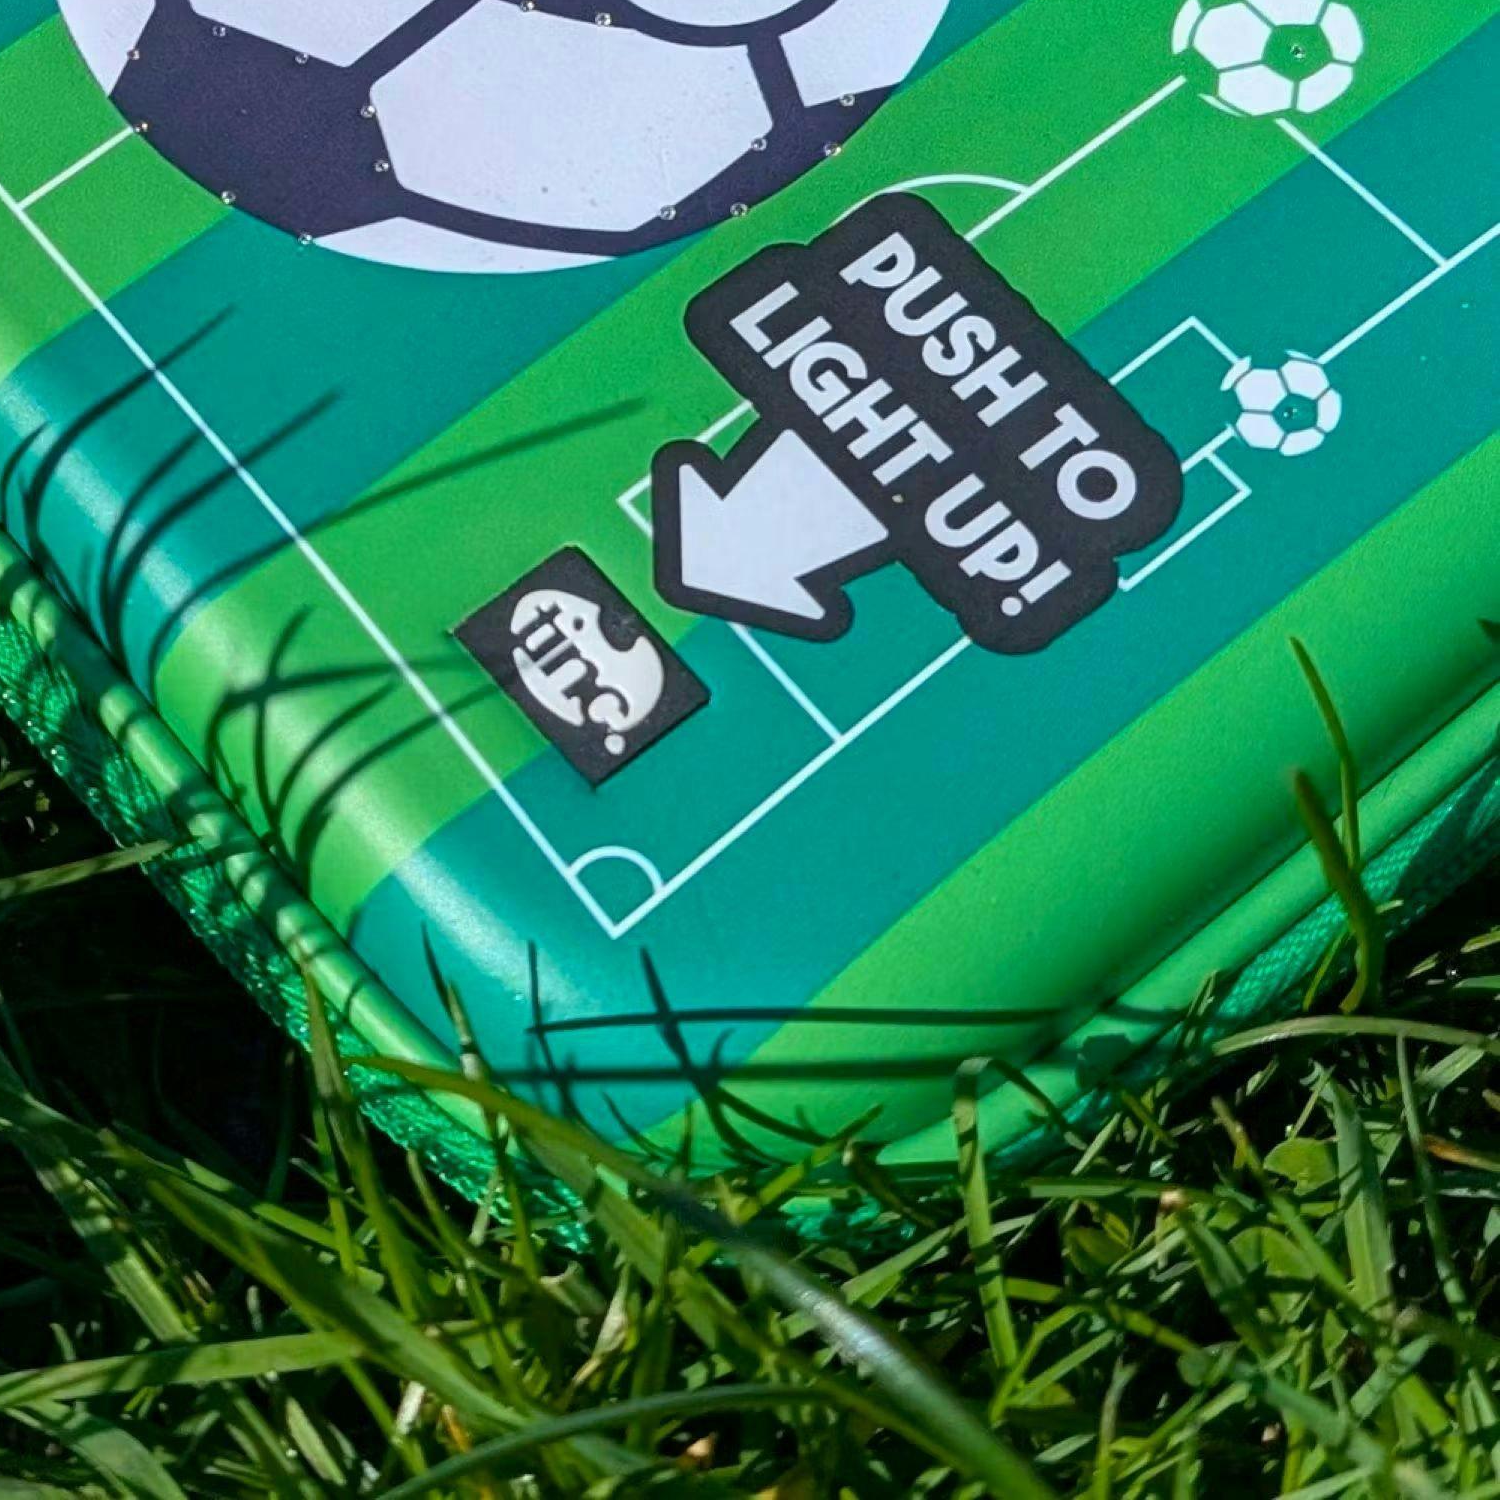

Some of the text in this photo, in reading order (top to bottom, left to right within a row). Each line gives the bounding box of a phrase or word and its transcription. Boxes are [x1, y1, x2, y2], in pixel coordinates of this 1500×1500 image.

[730, 281, 1072, 618] LIGHT UP!
[841, 232, 1137, 520] PUSH TO
